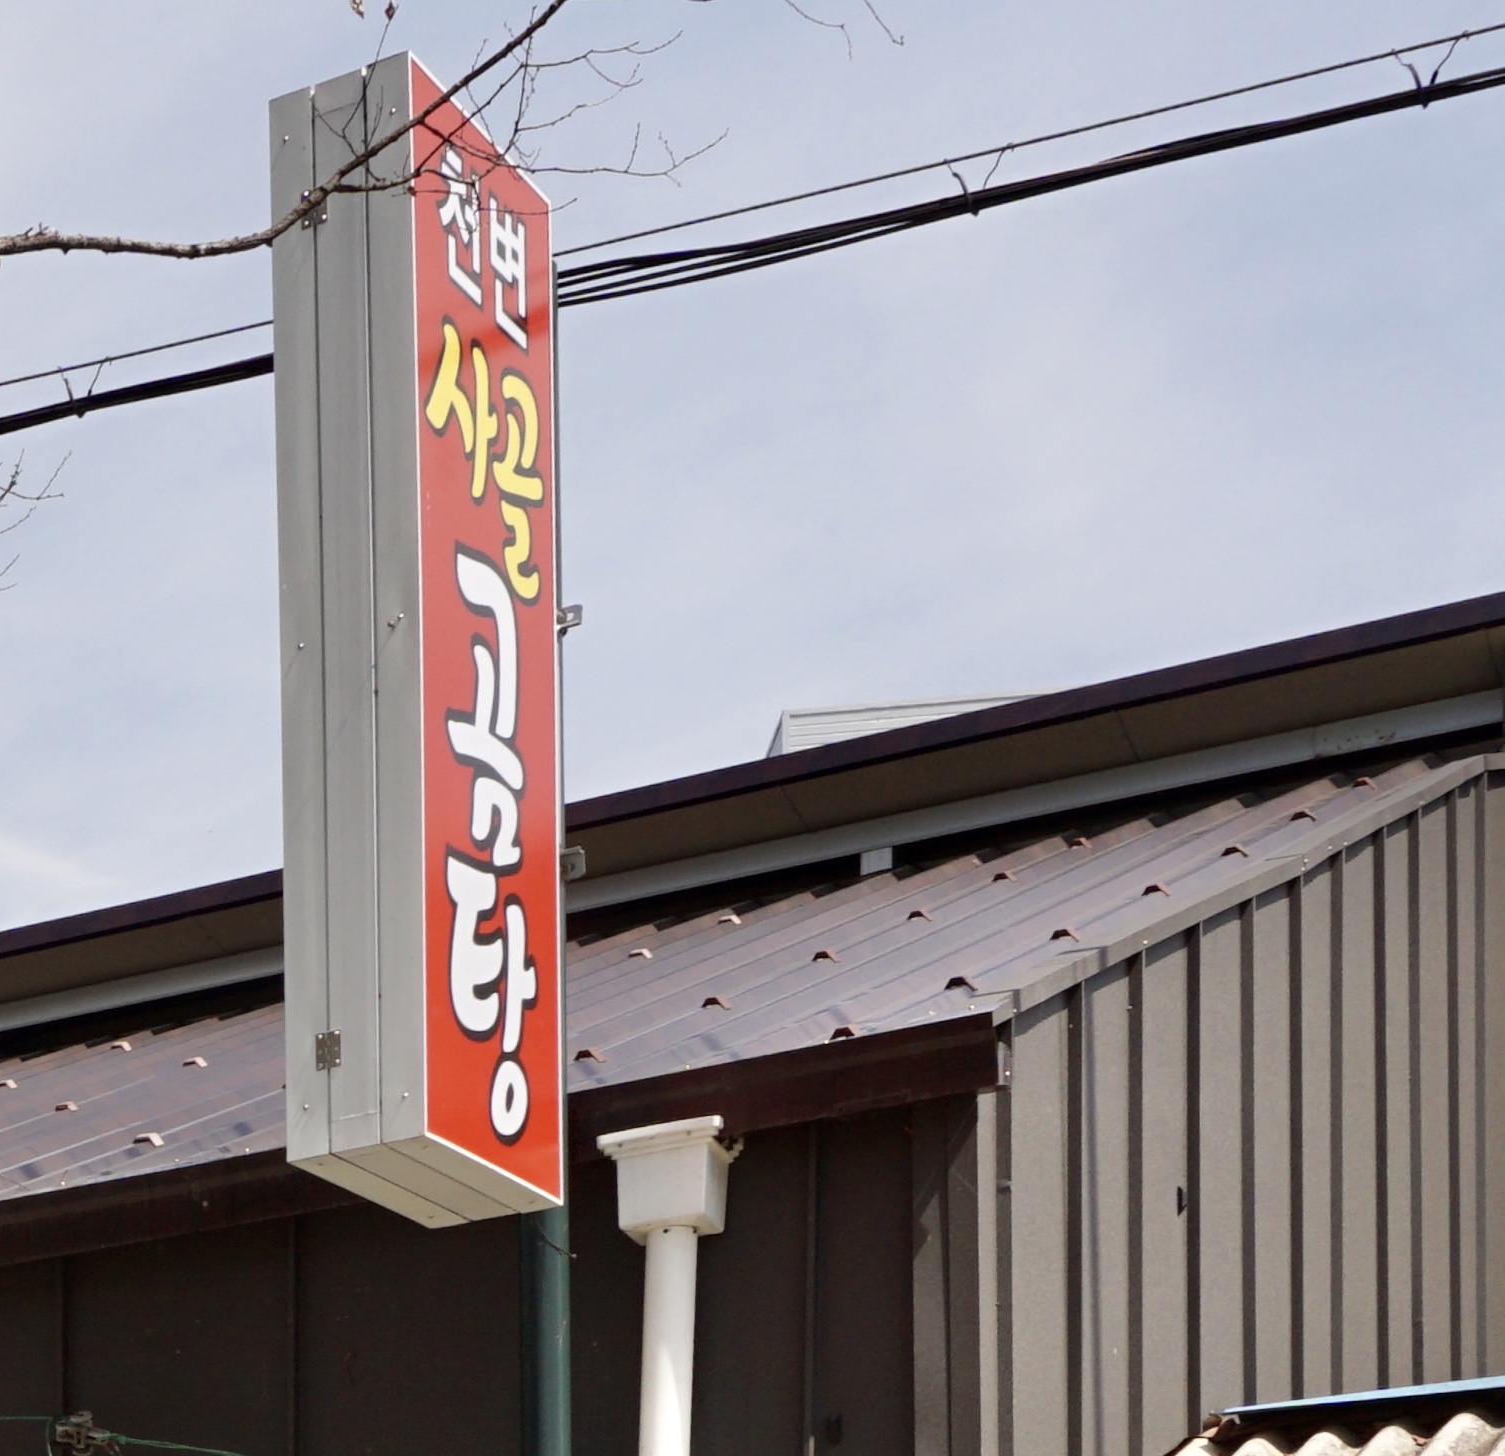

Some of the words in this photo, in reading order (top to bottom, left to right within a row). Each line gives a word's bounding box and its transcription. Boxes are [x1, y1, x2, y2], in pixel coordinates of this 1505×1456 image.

[439, 146, 528, 350] 천변
[424, 321, 545, 601] 사골
[446, 552, 538, 1138] 곰탕
